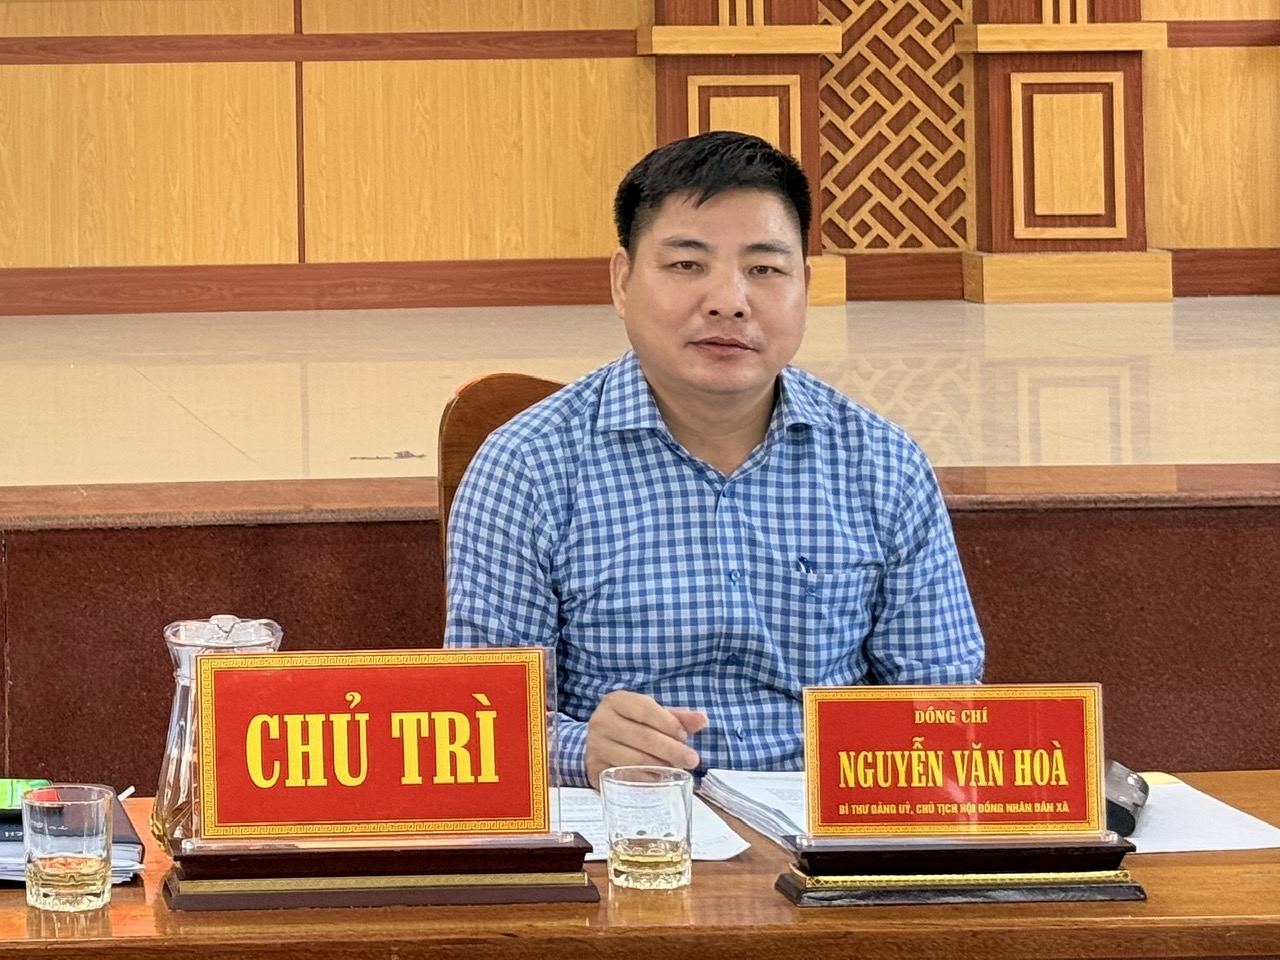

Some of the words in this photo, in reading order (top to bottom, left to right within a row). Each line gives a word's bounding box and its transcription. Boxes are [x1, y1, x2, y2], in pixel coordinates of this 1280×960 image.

[962, 707, 987, 723] CHÍ
[246, 692, 369, 788] CHỦ
[391, 694, 499, 784] TRÌ
[839, 737, 943, 787] NGUYỄN
[951, 743, 1003, 788] VĂN
[1014, 741, 1068, 785] HOÀ
[852, 804, 869, 814] THƯ
